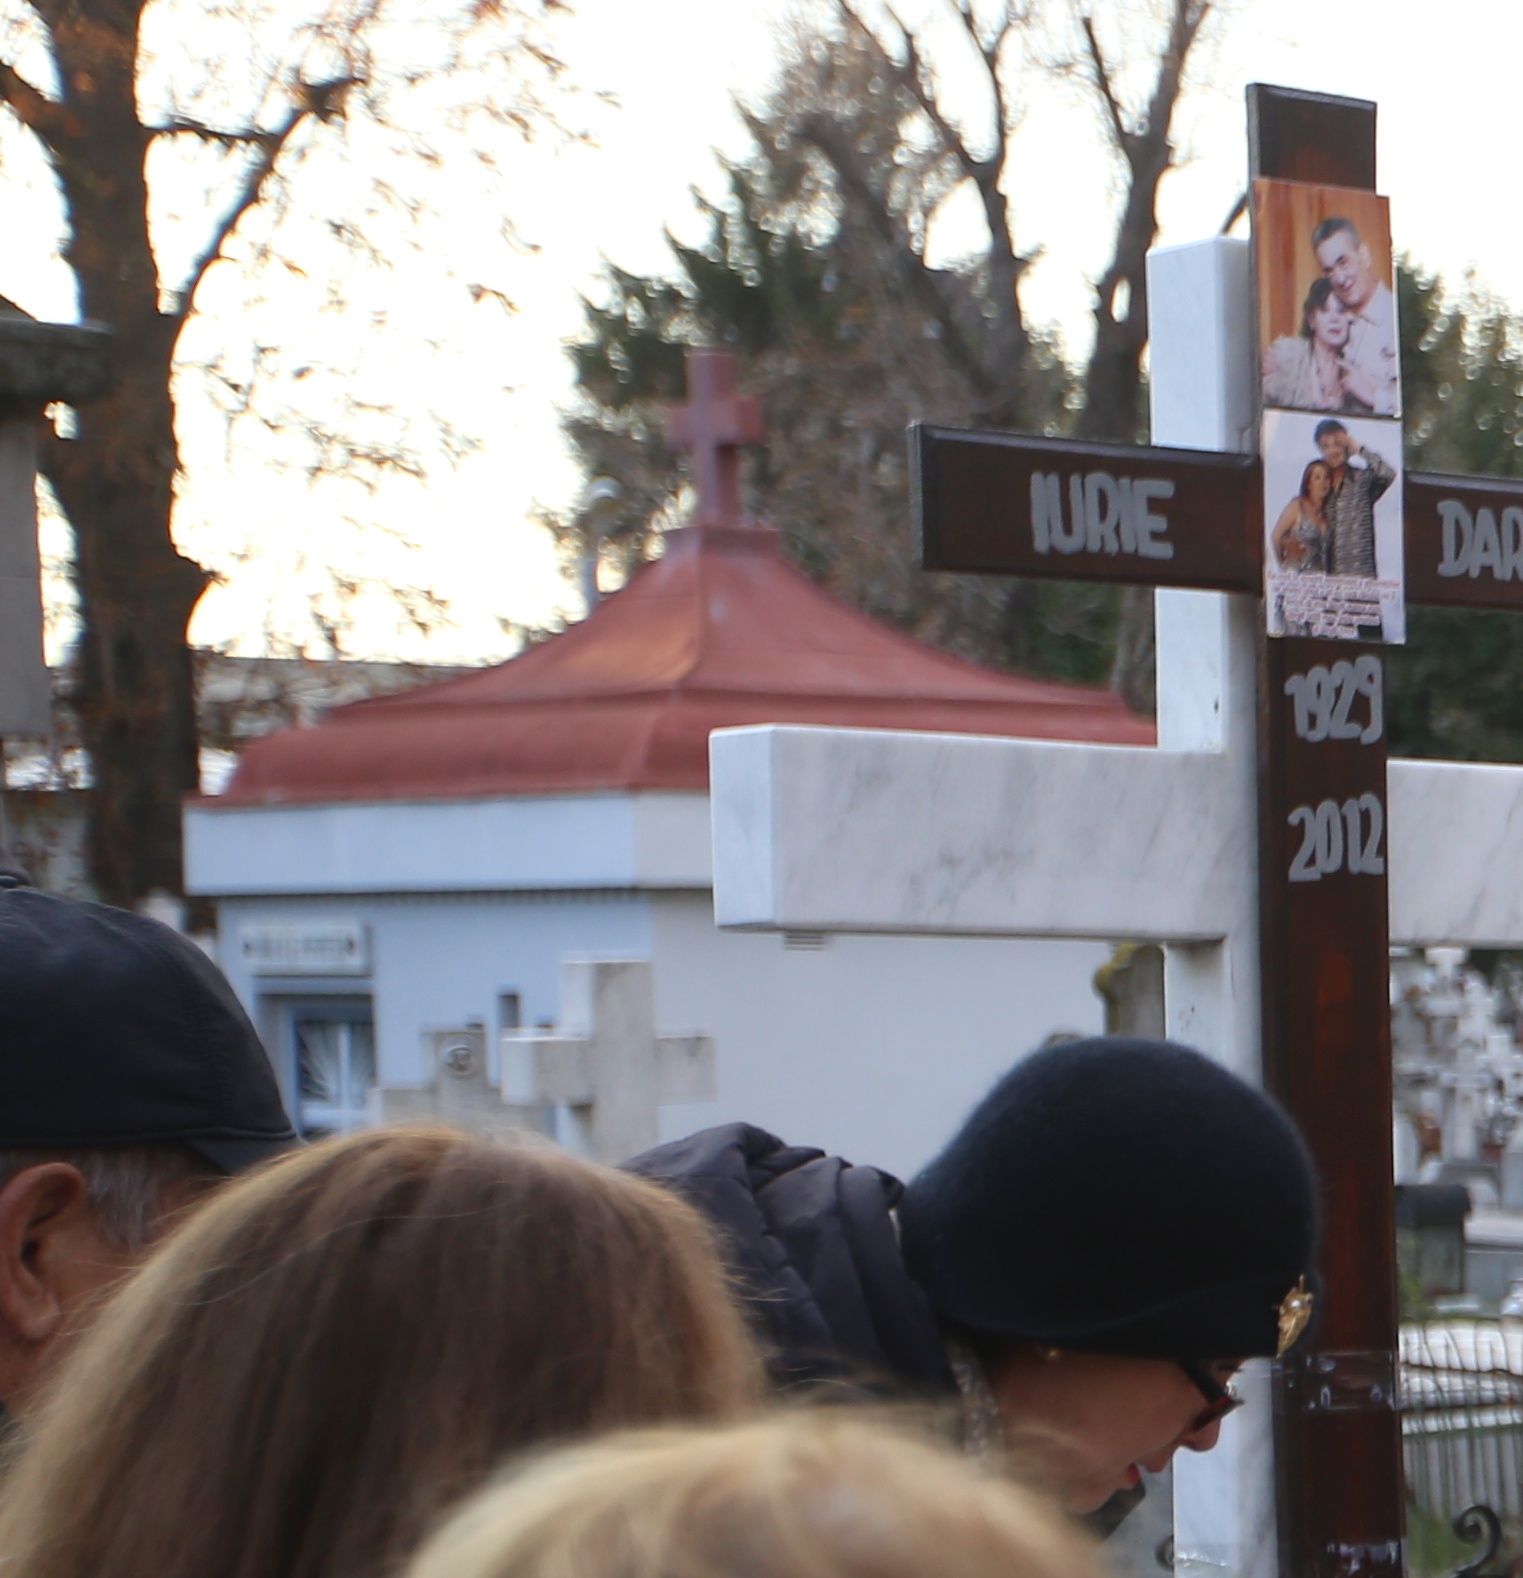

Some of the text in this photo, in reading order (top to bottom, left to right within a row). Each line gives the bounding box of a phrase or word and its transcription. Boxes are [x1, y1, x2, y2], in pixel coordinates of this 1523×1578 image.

[1030, 471, 1175, 559] IURIE
[1284, 655, 1383, 745] 1929
[1287, 791, 1385, 882] 2012
